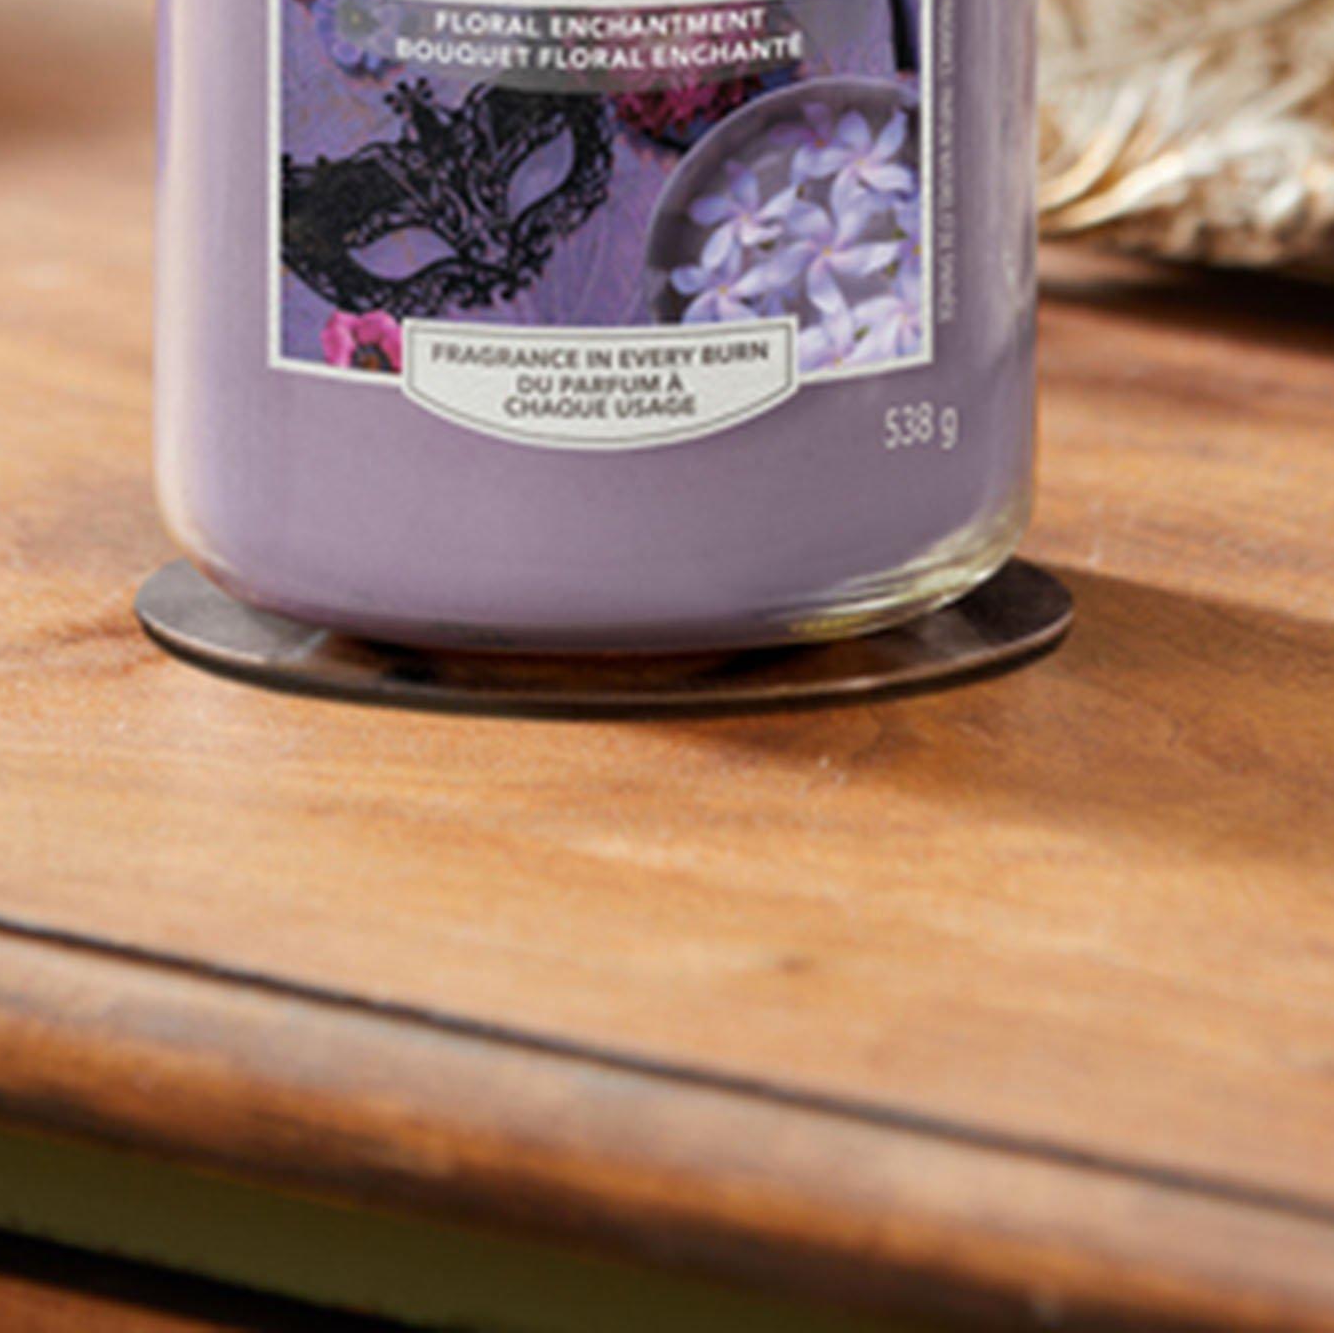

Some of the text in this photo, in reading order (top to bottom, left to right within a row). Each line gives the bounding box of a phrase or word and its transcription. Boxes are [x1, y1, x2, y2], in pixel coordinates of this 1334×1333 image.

[434, 7, 766, 38] FLORAL ENCHANTMENT
[395, 31, 804, 70] BOUQUET FLORAL ENCHANTÉ
[431, 340, 770, 370] FRAGRANCE IN EVERY BURN
[516, 370, 685, 395] DU PARFUM À
[503, 396, 697, 419] CHAQUE USAGE
[884, 402, 960, 450] 538 g
